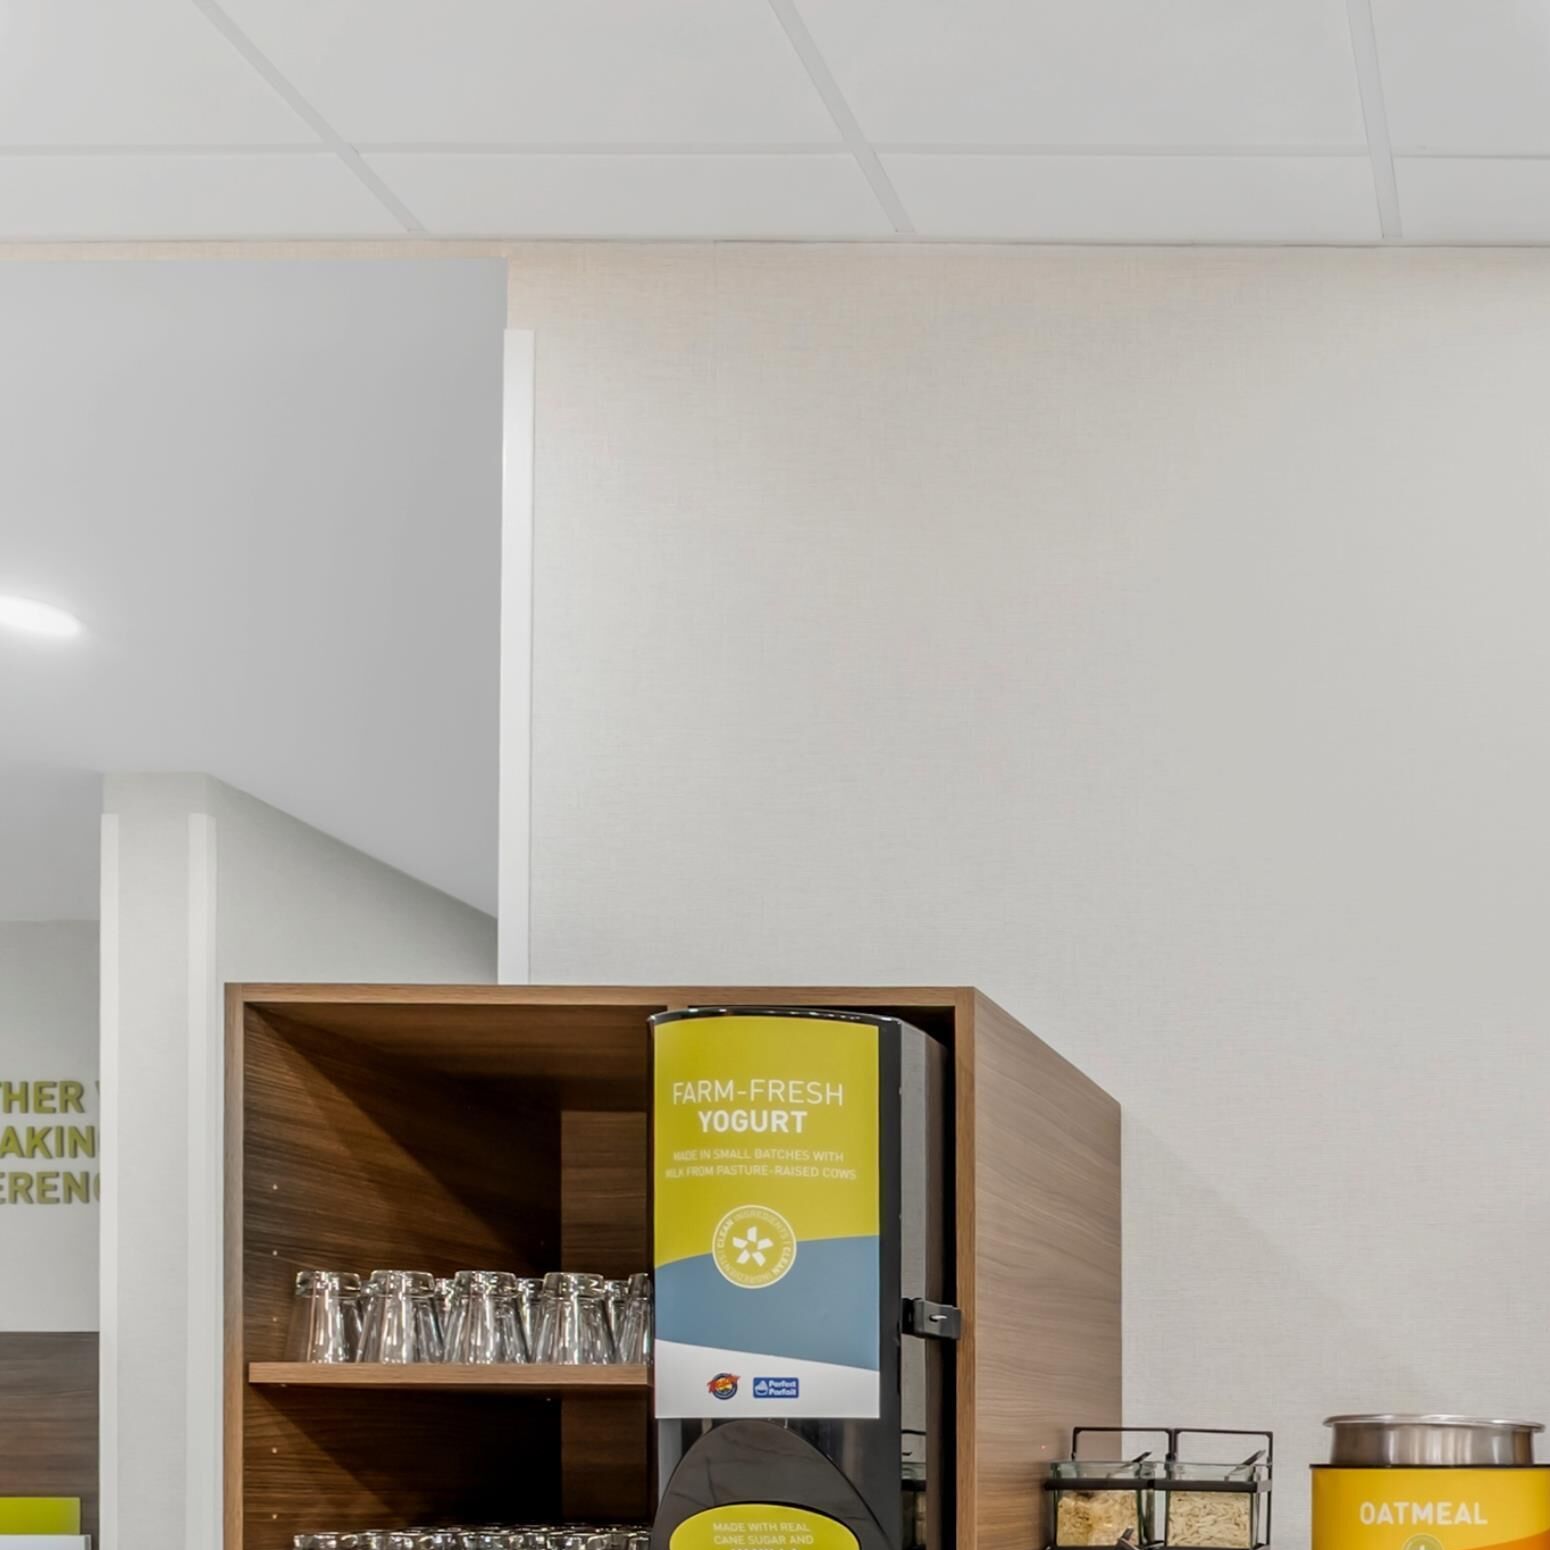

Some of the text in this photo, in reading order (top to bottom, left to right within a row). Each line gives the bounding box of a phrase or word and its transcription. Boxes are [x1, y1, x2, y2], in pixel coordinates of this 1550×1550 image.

[671, 1079, 844, 1106] FARM-FRESH
[698, 1109, 808, 1133] YOGURT
[0, 1126, 100, 1159] AKIN
[673, 1148, 844, 1162] MADE IN SMALL BATCHES WITH
[686, 1166, 714, 1177] FROM
[716, 1164, 819, 1178] PASTURE-RAISED
[822, 1168, 857, 1180] COWS
[0, 1170, 100, 1205] REN
[768, 1379, 797, 1388] Perfect
[768, 1388, 797, 1396] Parfait
[1359, 1501, 1488, 1525] OATMEAL
[713, 1522, 811, 1532] MADE WITH REAL
[713, 1535, 814, 1545] CANE SUGAR AND
